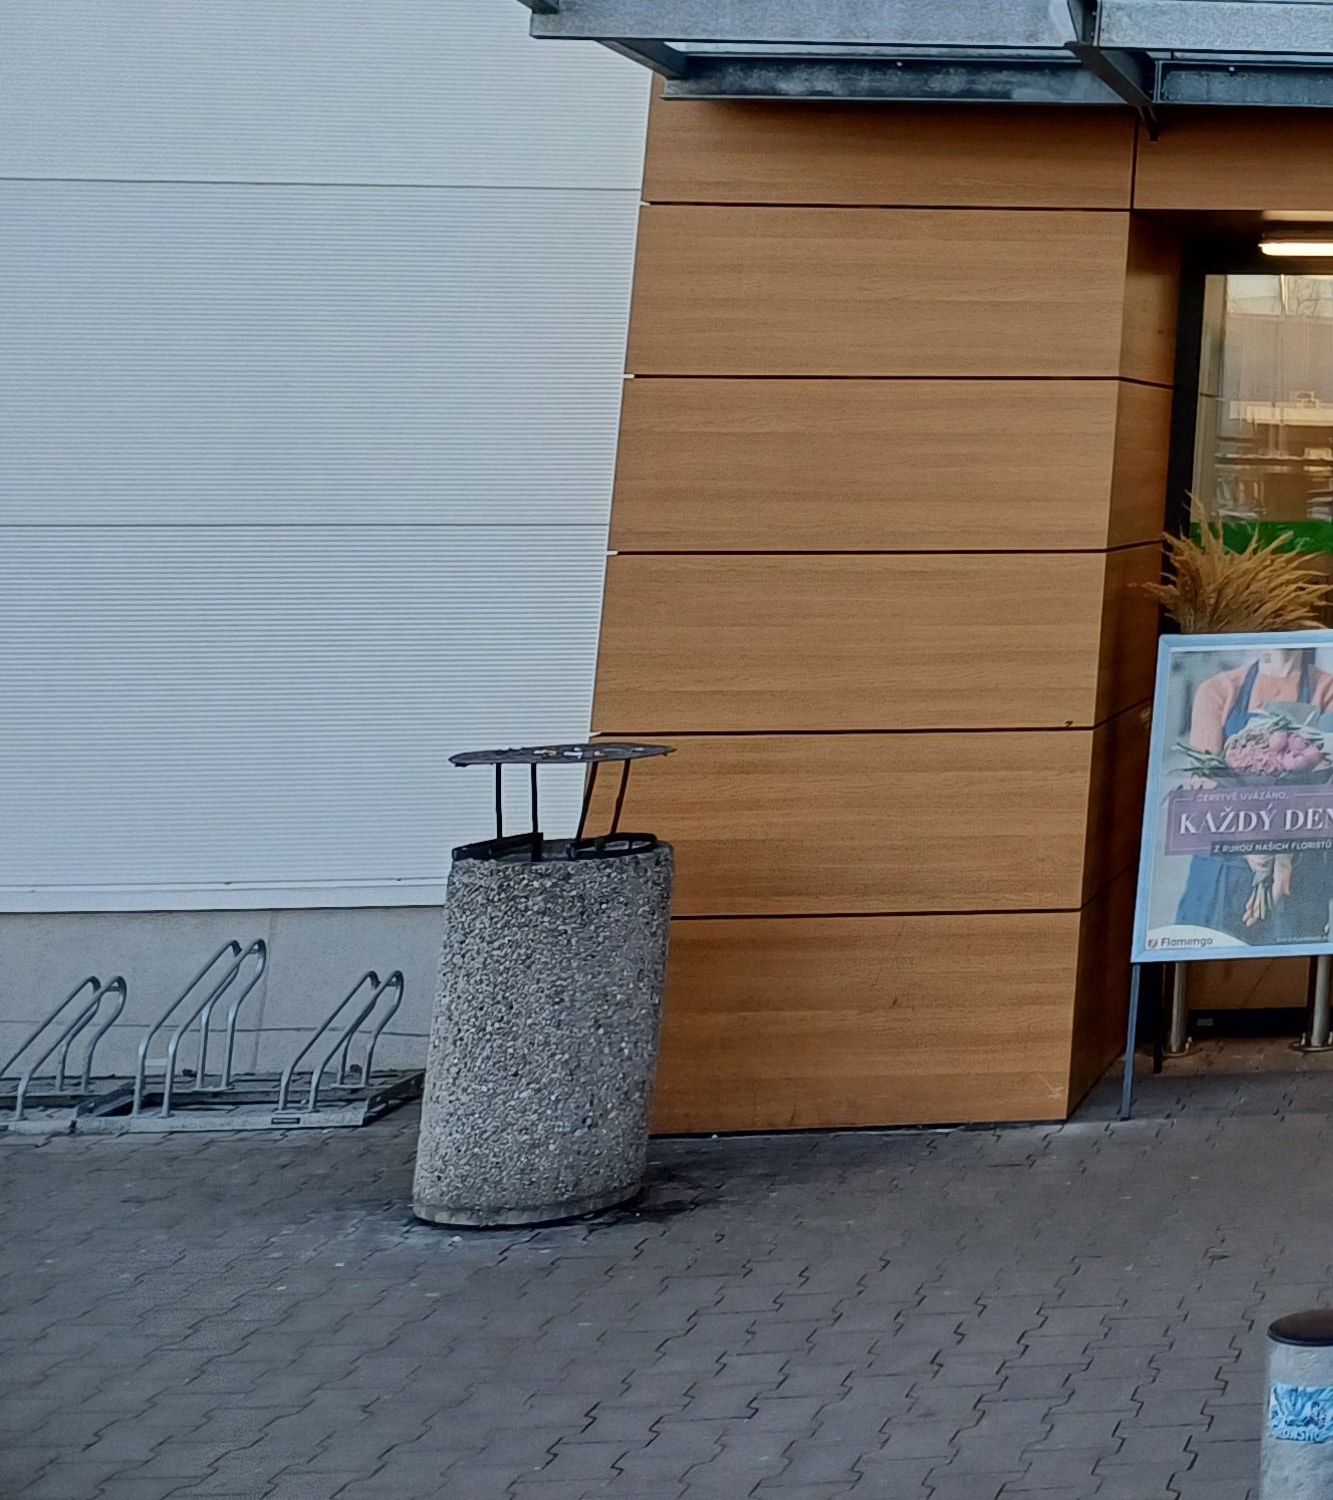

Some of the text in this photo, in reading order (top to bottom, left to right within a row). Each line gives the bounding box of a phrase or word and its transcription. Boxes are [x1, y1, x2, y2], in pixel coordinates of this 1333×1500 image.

[1178, 802, 1278, 835] KAŽDÝ
[1213, 844, 1221, 853] Z
[1255, 841, 1289, 852] NAŠICH
[1160, 936, 1214, 948] Flamengo
